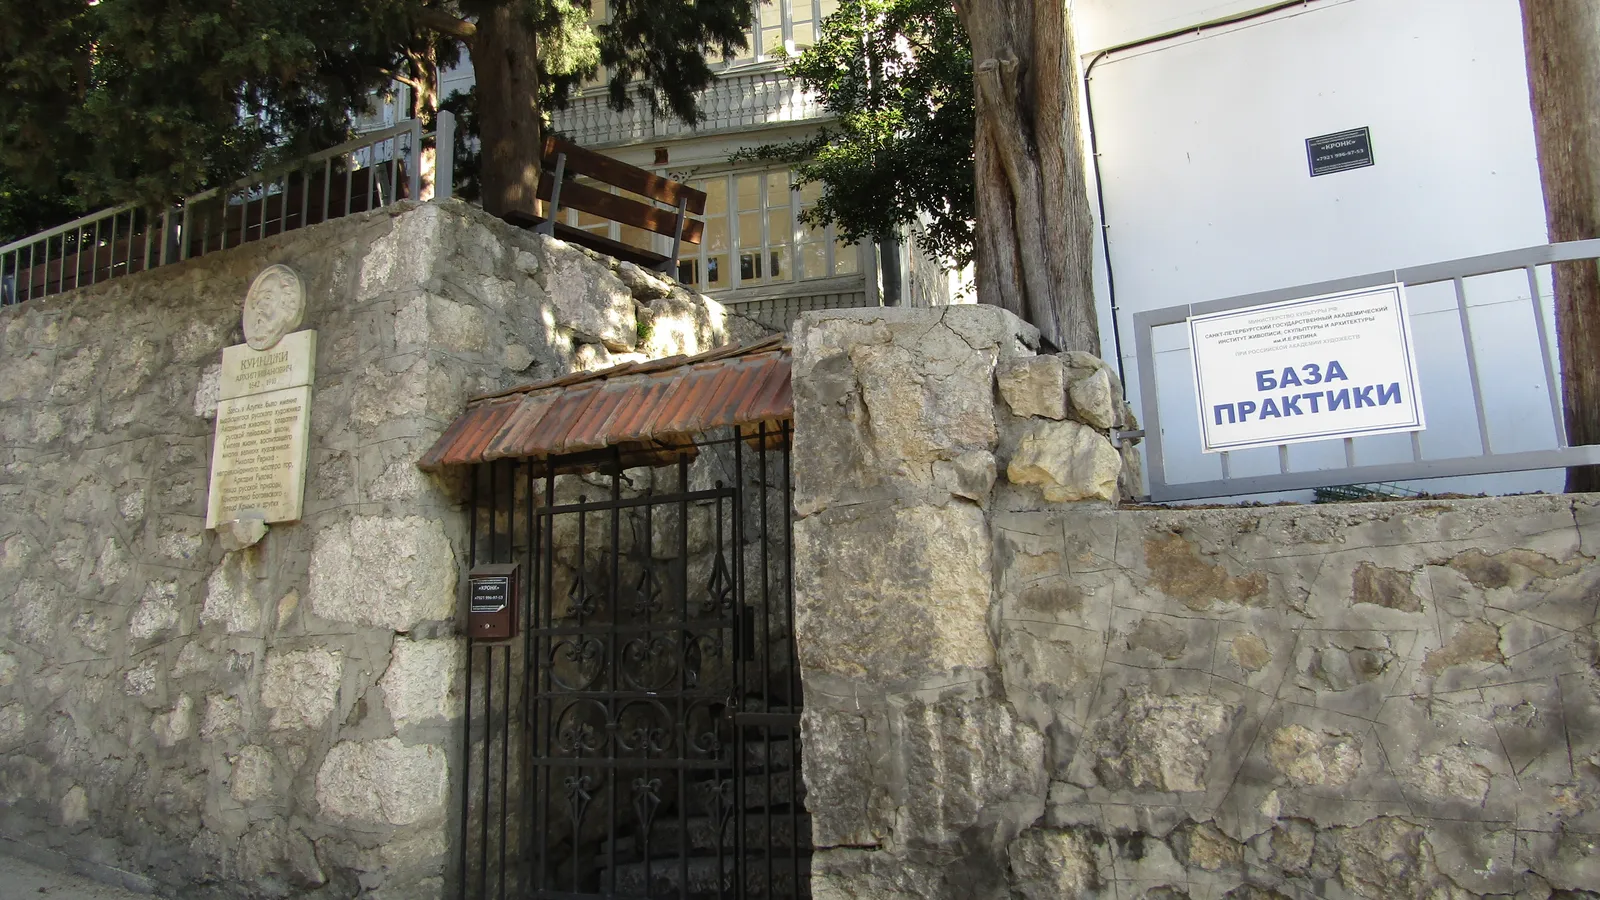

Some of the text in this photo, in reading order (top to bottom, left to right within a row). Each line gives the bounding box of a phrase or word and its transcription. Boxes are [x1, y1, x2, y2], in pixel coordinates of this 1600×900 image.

[1321, 140, 1356, 150] «КРОНК»
[1205, 306, 1388, 339] САНКТ-ПЕТЕРБУРГСКИЙ ГОСУДАРСТВЕННЫЙ АКАДЕМИЧЕСКИЙ
[1248, 313, 1294, 324] МИНИСТЕРСТВО
[1296, 308, 1327, 318] КУЛЬТУРЫ
[1218, 336, 1247, 344] ИНСТИТУТ
[1284, 325, 1323, 334] СКУЛЬПТУРЫ
[1330, 316, 1375, 327] АРХИТЕКТУРЫ
[1248, 345, 1288, 355] РОССИЙСКОЙ
[1289, 340, 1321, 348] АКАДЕМИИ
[1323, 334, 1360, 344] ХУДОЖЕСТВ
[240, 351, 288, 370] КУИНДЖИ
[236, 364, 292, 382] АРХИП ИВАНОВИЧ
[1256, 360, 1348, 392] БАЗА
[1214, 382, 1402, 425] ПРАКТИКИ
[251, 411, 273, 421] русского
[275, 406, 301, 416] художника
[225, 432, 244, 441] русской
[246, 428, 272, 436] пейзажной
[239, 483, 258, 494] русской
